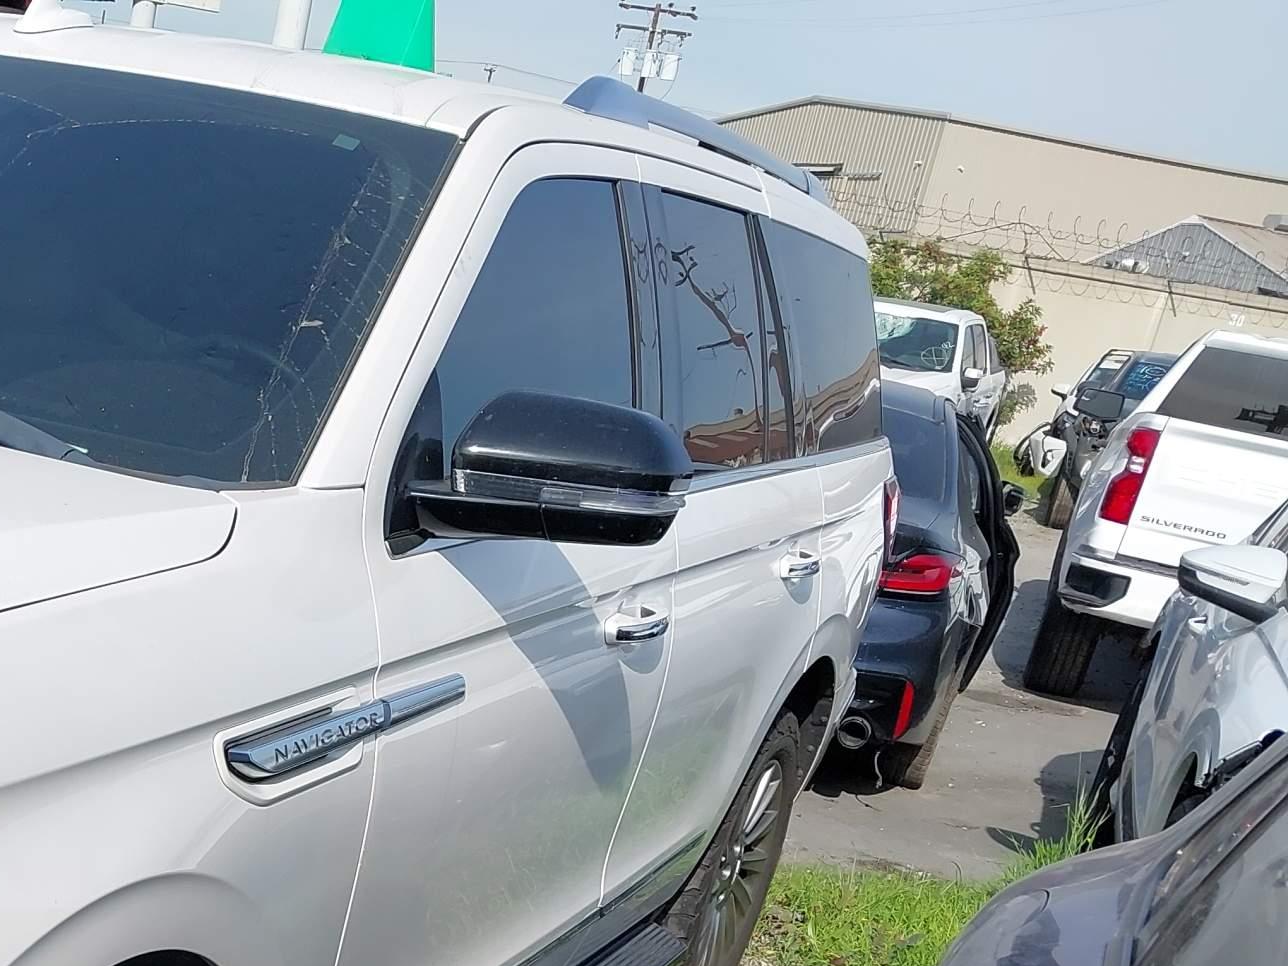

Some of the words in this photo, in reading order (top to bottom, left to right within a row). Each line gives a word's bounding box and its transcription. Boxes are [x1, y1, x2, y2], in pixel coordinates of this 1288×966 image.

[1228, 313, 1246, 327] 30
[1140, 514, 1227, 539] SILVERADO
[272, 711, 380, 765] NAVIGATOR
